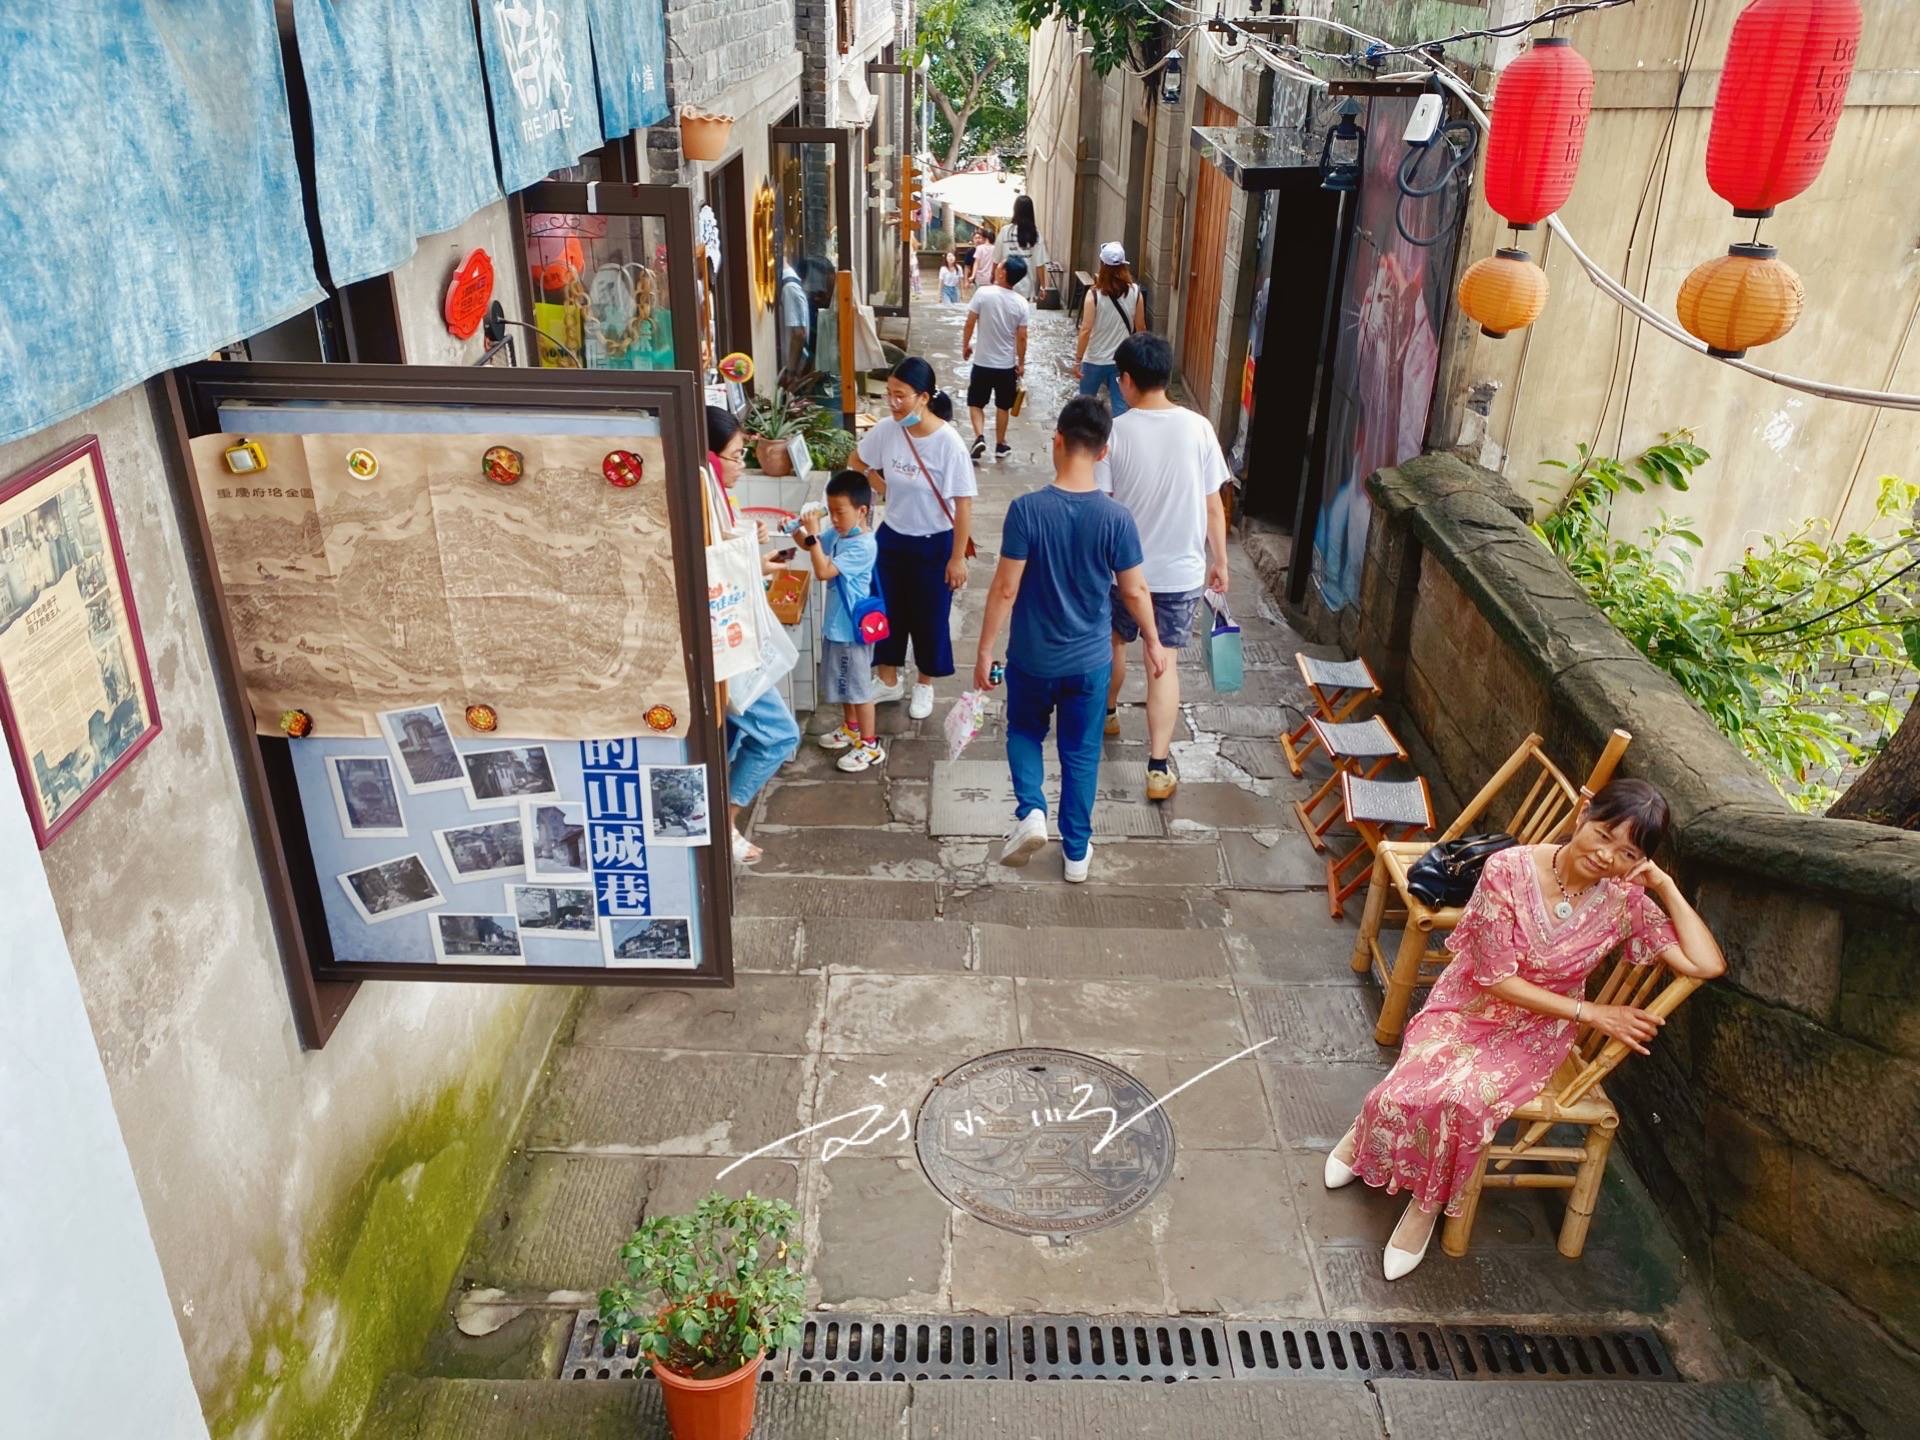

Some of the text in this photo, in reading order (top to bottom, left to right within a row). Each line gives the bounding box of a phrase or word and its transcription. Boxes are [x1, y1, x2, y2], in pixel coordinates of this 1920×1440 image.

[521, 116, 544, 144] THE
[583, 740, 649, 916] 的山城巷
